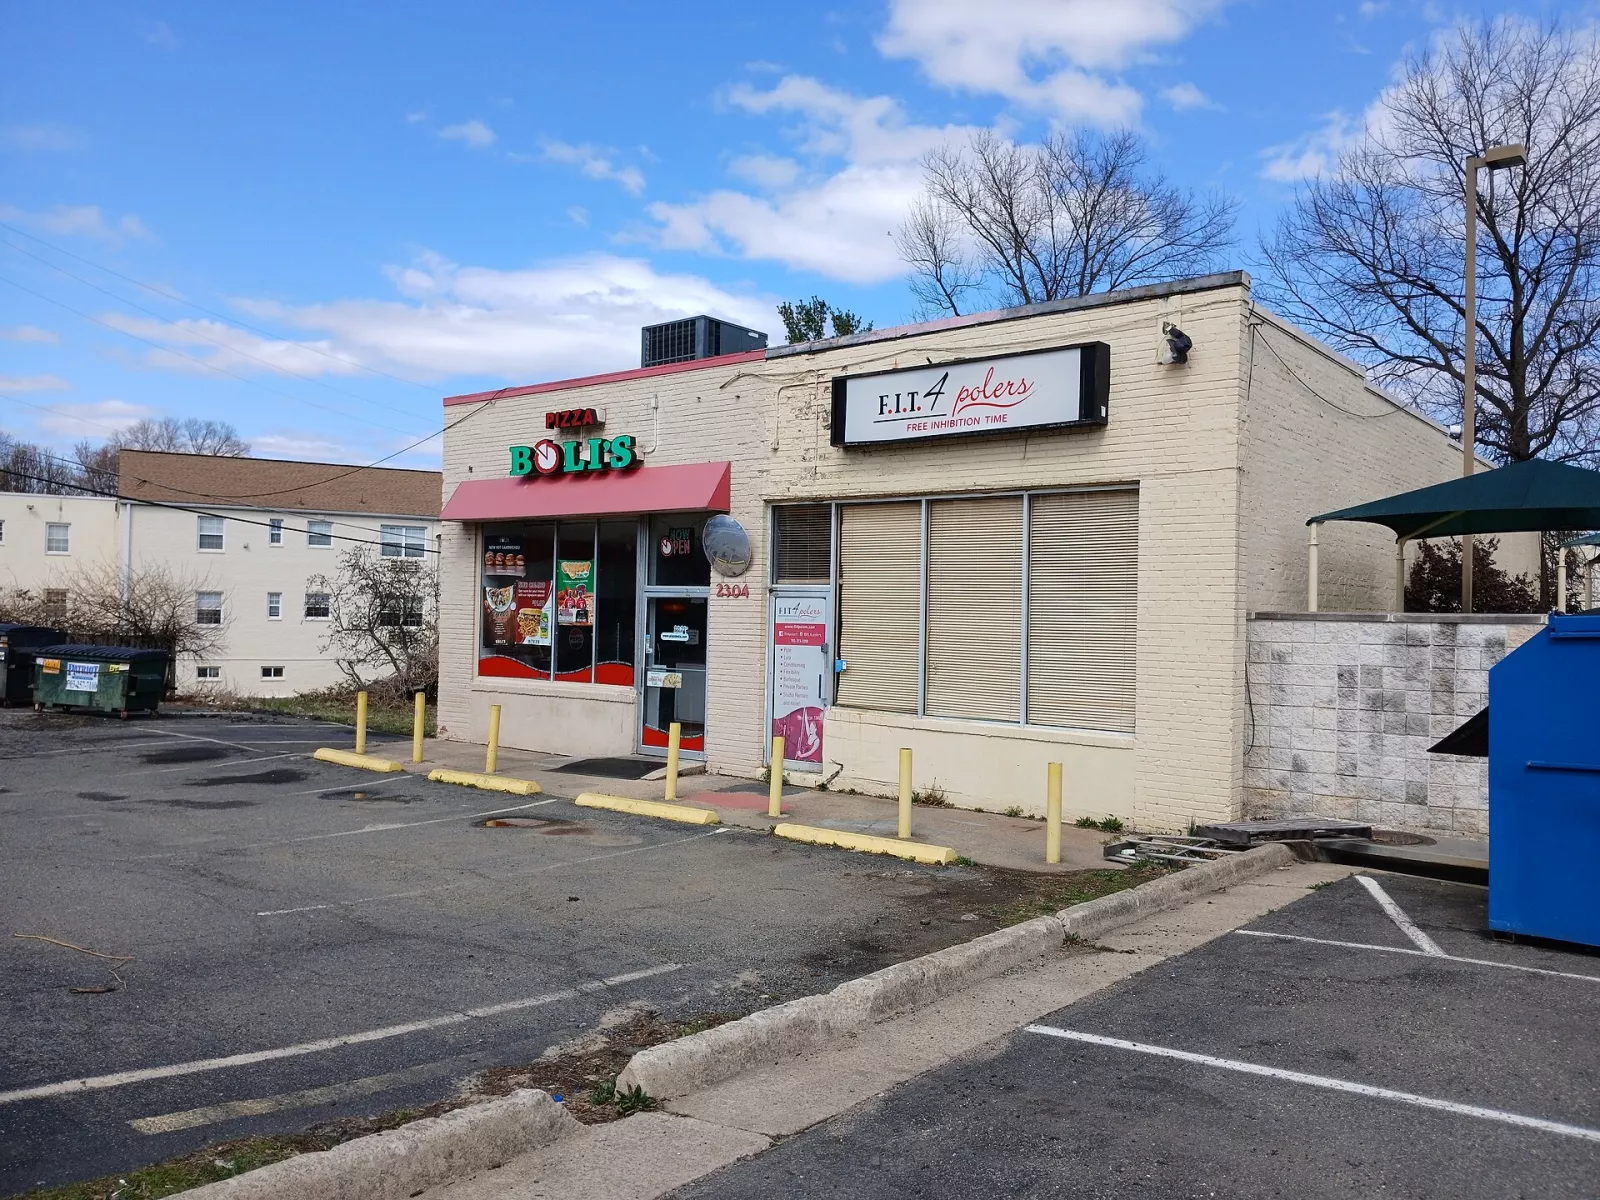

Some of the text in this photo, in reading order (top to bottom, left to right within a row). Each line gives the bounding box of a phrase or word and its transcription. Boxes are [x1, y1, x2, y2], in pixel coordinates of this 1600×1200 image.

[923, 371, 949, 411] 4
[952, 366, 1035, 417] polers
[545, 408, 597, 429] PIZZA
[906, 413, 1008, 432] FREE INHIBITION TIME
[509, 435, 636, 476] BOLI'S
[670, 529, 691, 540] NOW
[661, 537, 691, 556] OPEN
[716, 583, 750, 599] 2304
[68, 664, 98, 677] PATRIOT
